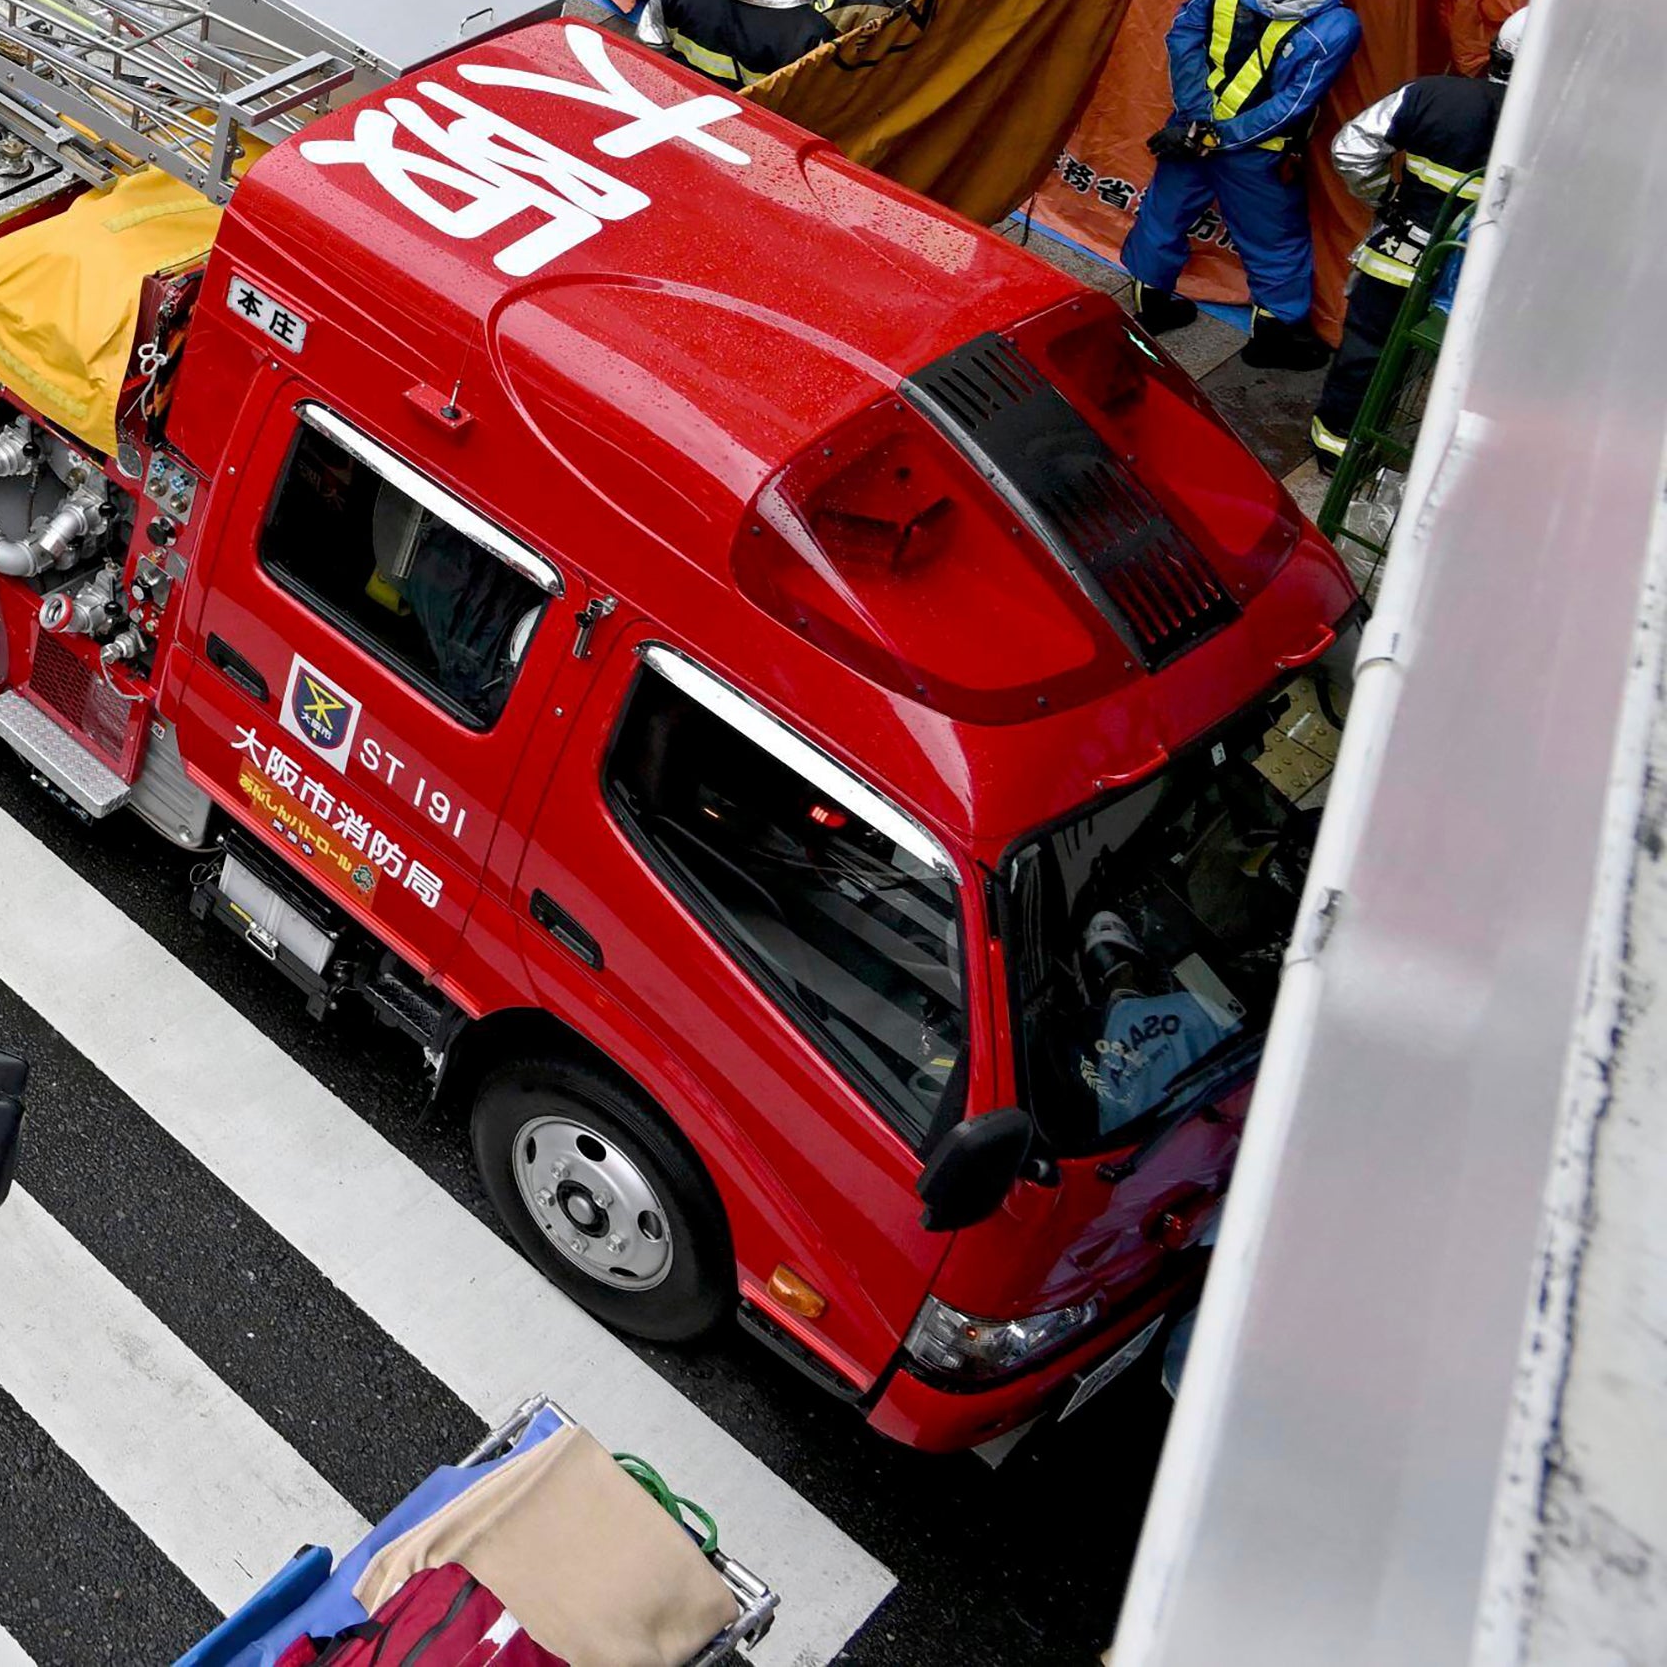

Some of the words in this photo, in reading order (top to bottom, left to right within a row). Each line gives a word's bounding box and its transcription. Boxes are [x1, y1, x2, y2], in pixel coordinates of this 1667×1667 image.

[300, 24, 754, 278] 大阪
[237, 287, 297, 345] 本庄
[299, 710, 332, 741] 大阪市
[230, 724, 444, 909] 大阪市消防局
[238, 772, 353, 874] あんしんパトロール
[359, 737, 405, 785] ST
[414, 776, 469, 840] 191
